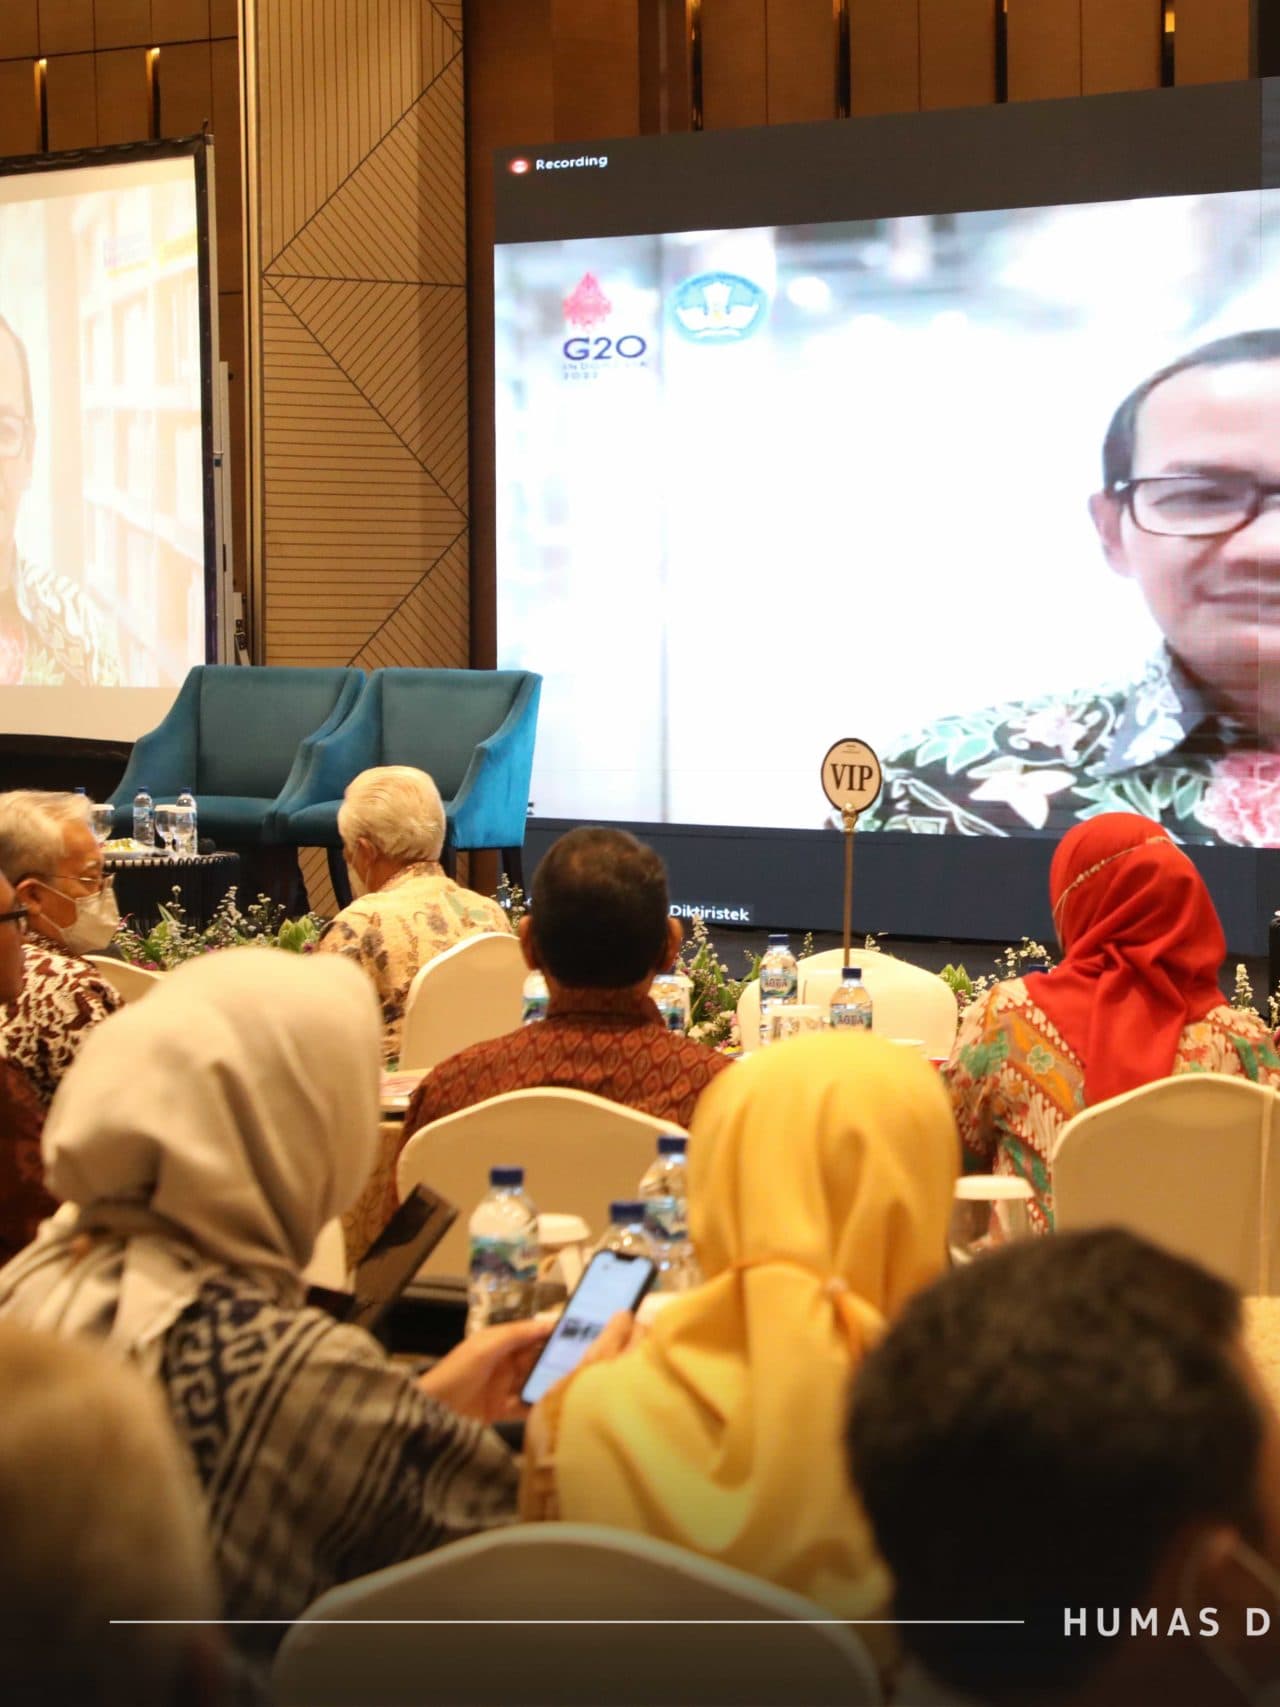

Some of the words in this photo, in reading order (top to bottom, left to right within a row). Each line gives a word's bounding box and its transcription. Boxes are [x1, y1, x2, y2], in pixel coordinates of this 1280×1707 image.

[536, 156, 608, 170] Recording
[563, 335, 647, 361] G20
[830, 763, 873, 792] VIP
[669, 904, 750, 921] Diktiristek
